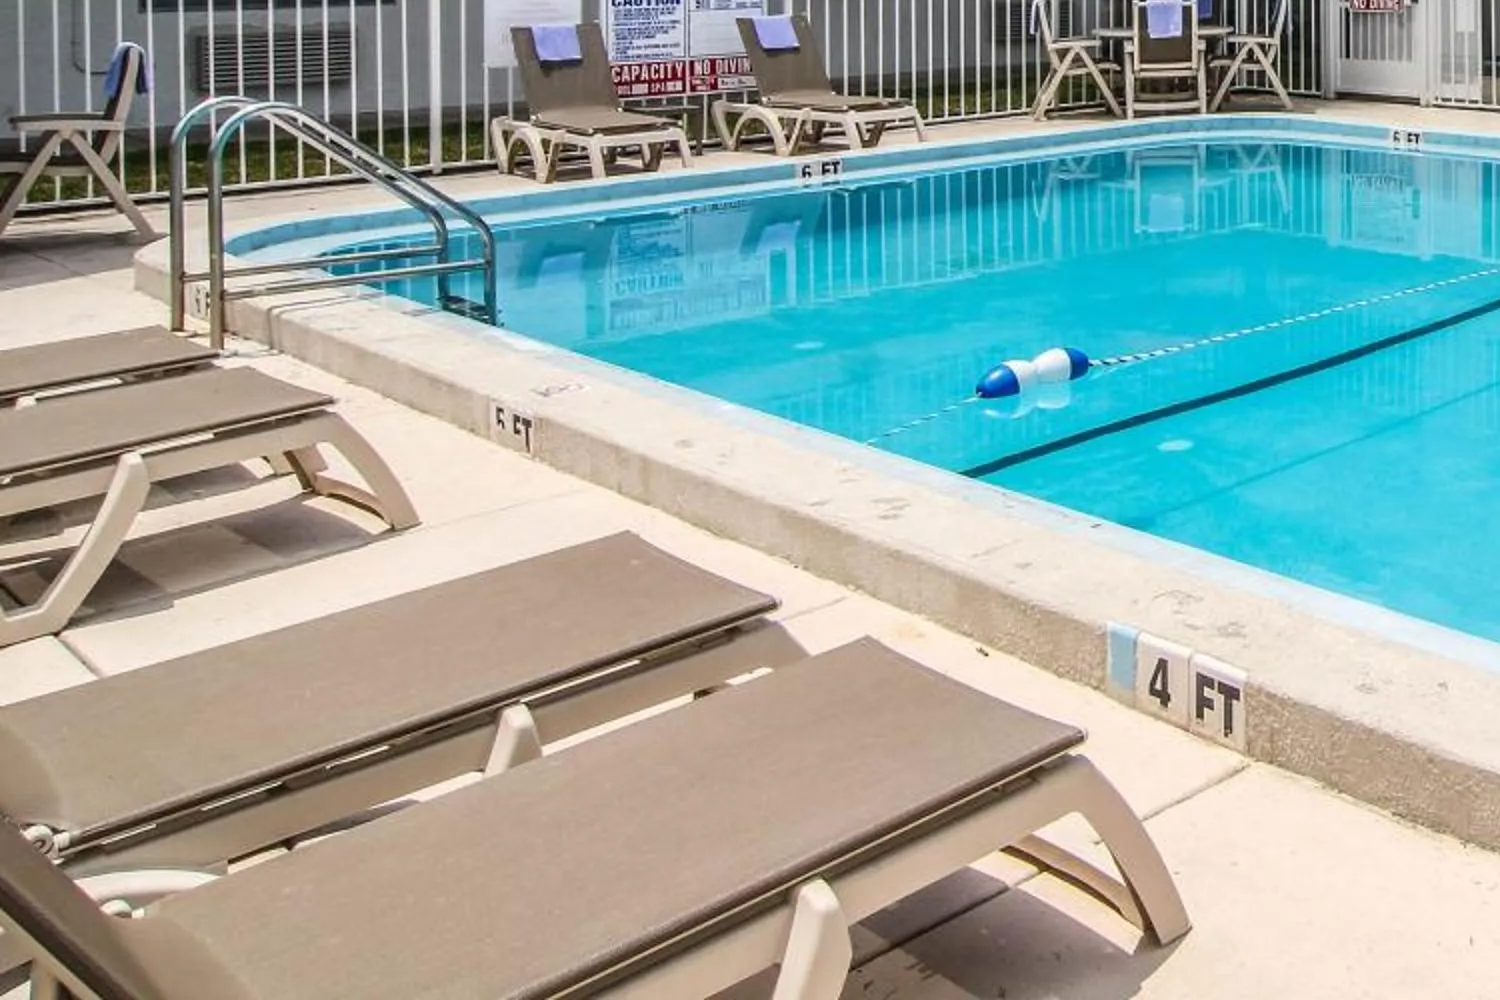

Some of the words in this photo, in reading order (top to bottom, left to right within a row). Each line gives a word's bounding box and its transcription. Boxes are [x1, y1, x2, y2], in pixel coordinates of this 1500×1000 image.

[611, 61, 683, 83] CAPACITY
[694, 59, 711, 75] NO
[715, 57, 751, 74] DIVIN
[821, 161, 840, 176] FT
[1148, 657, 1171, 708] 4
[1195, 671, 1241, 738] FT
